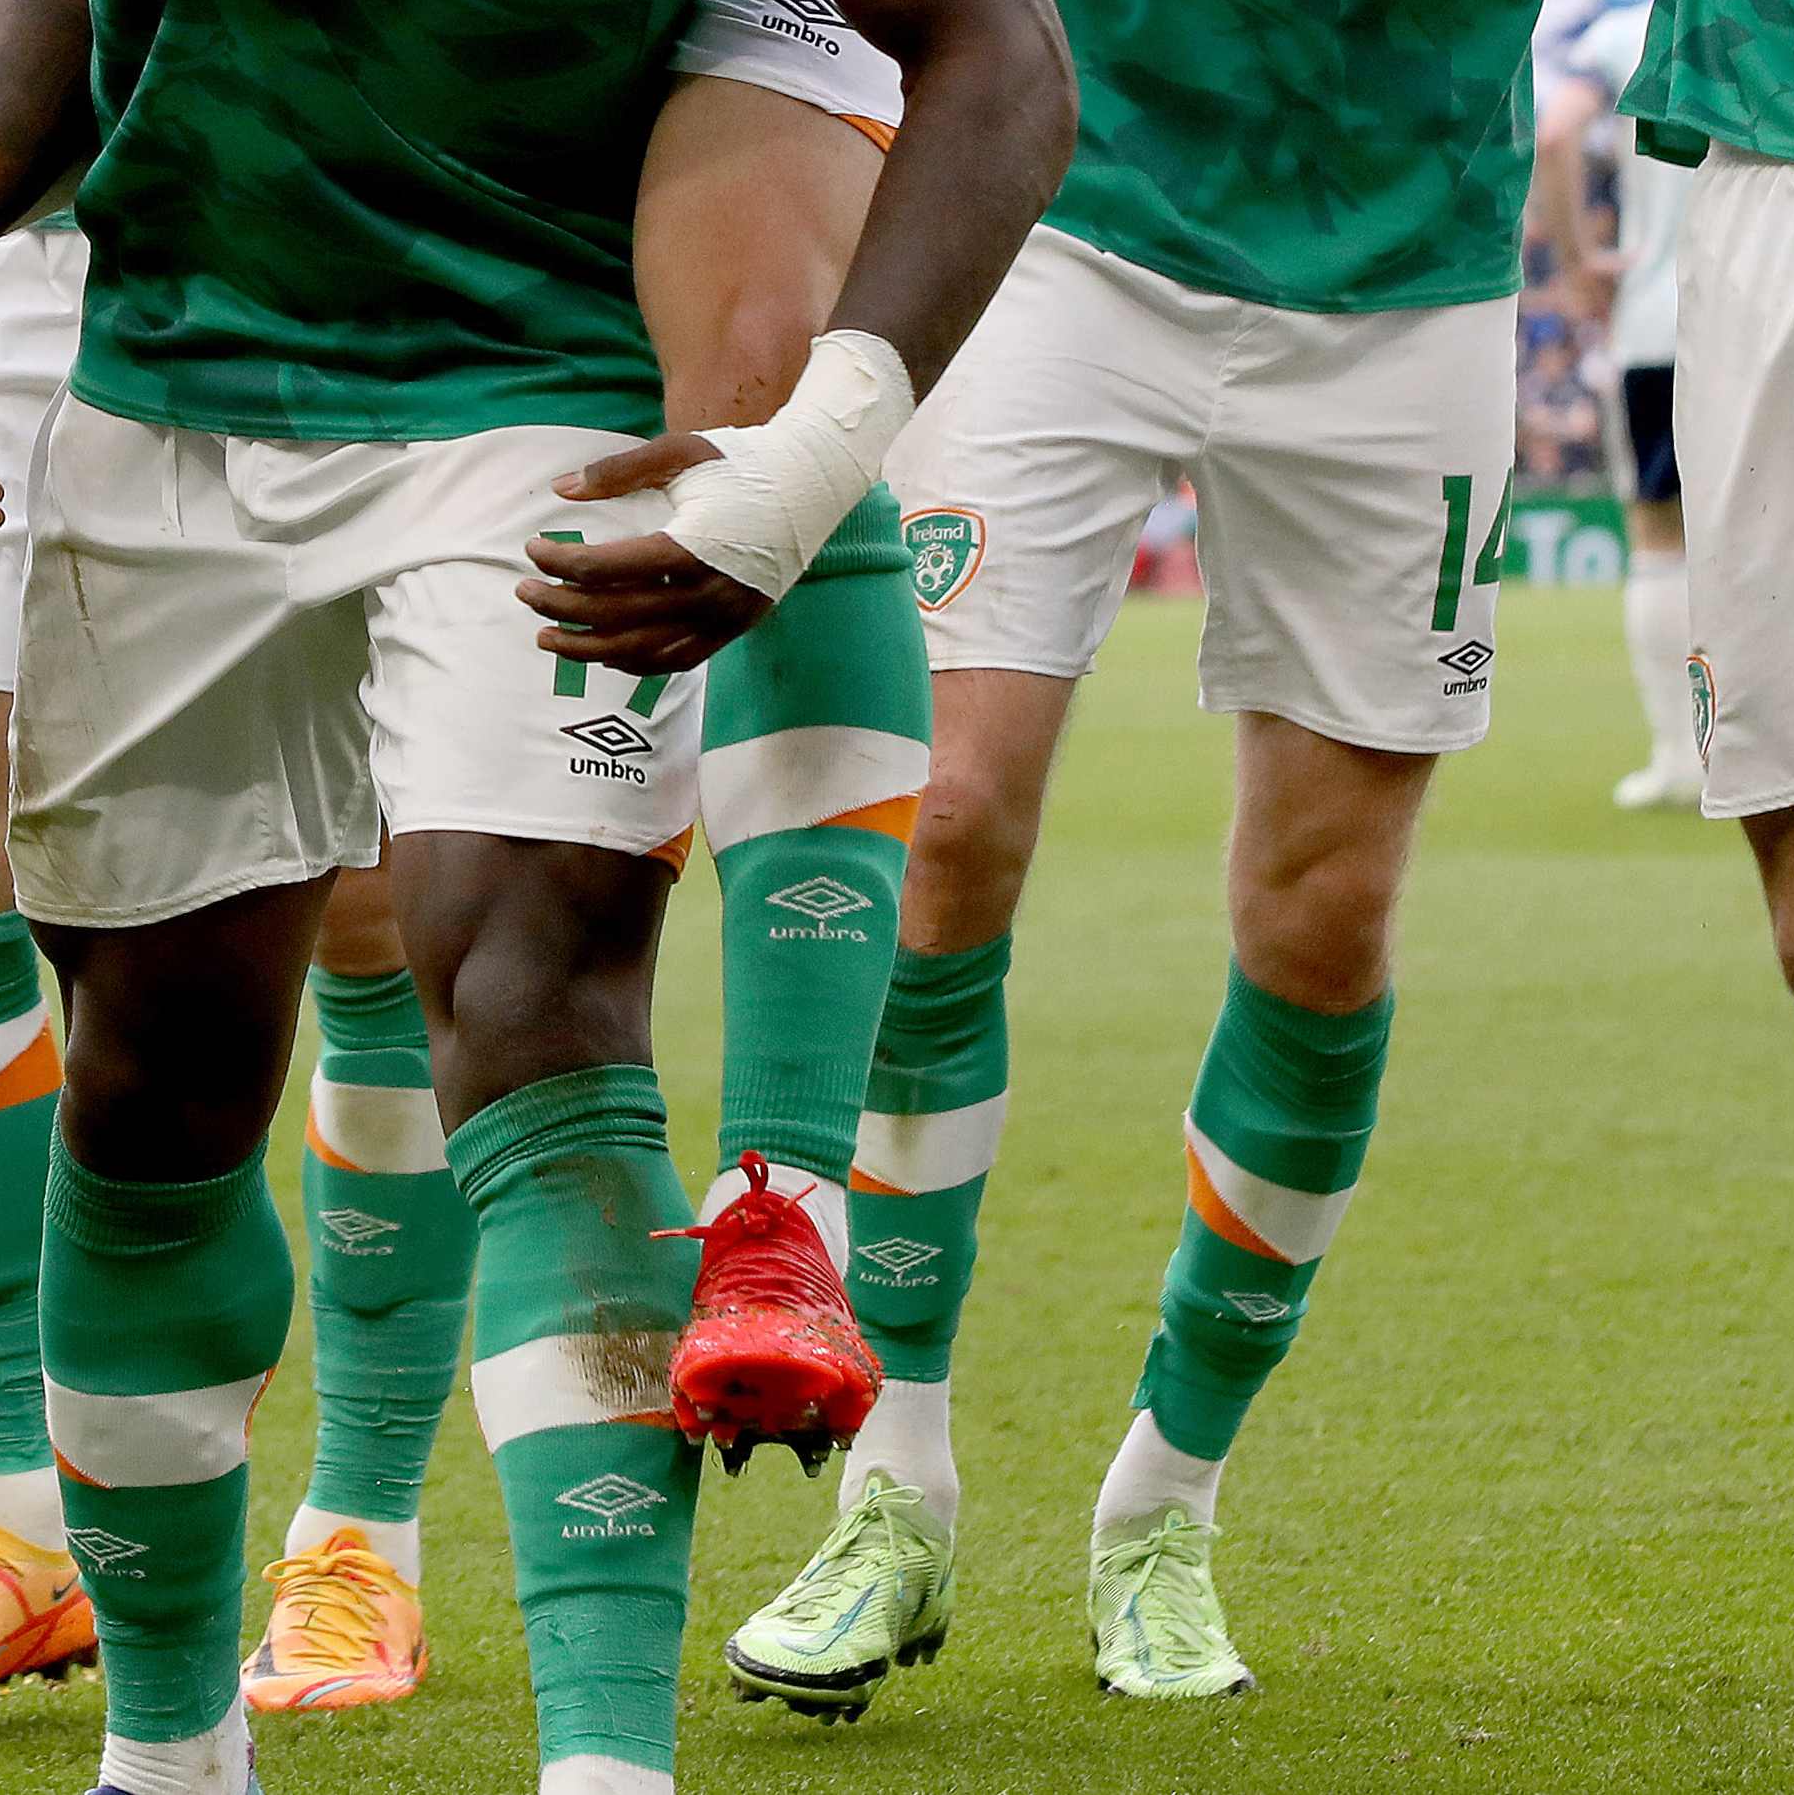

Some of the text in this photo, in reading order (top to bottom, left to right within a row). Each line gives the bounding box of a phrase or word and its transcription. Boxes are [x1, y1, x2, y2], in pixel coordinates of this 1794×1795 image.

[761, 14, 840, 57] umbro
[910, 522, 965, 543] Ireland
[1443, 677, 1488, 696] umbro
[570, 757, 646, 784] umbro
